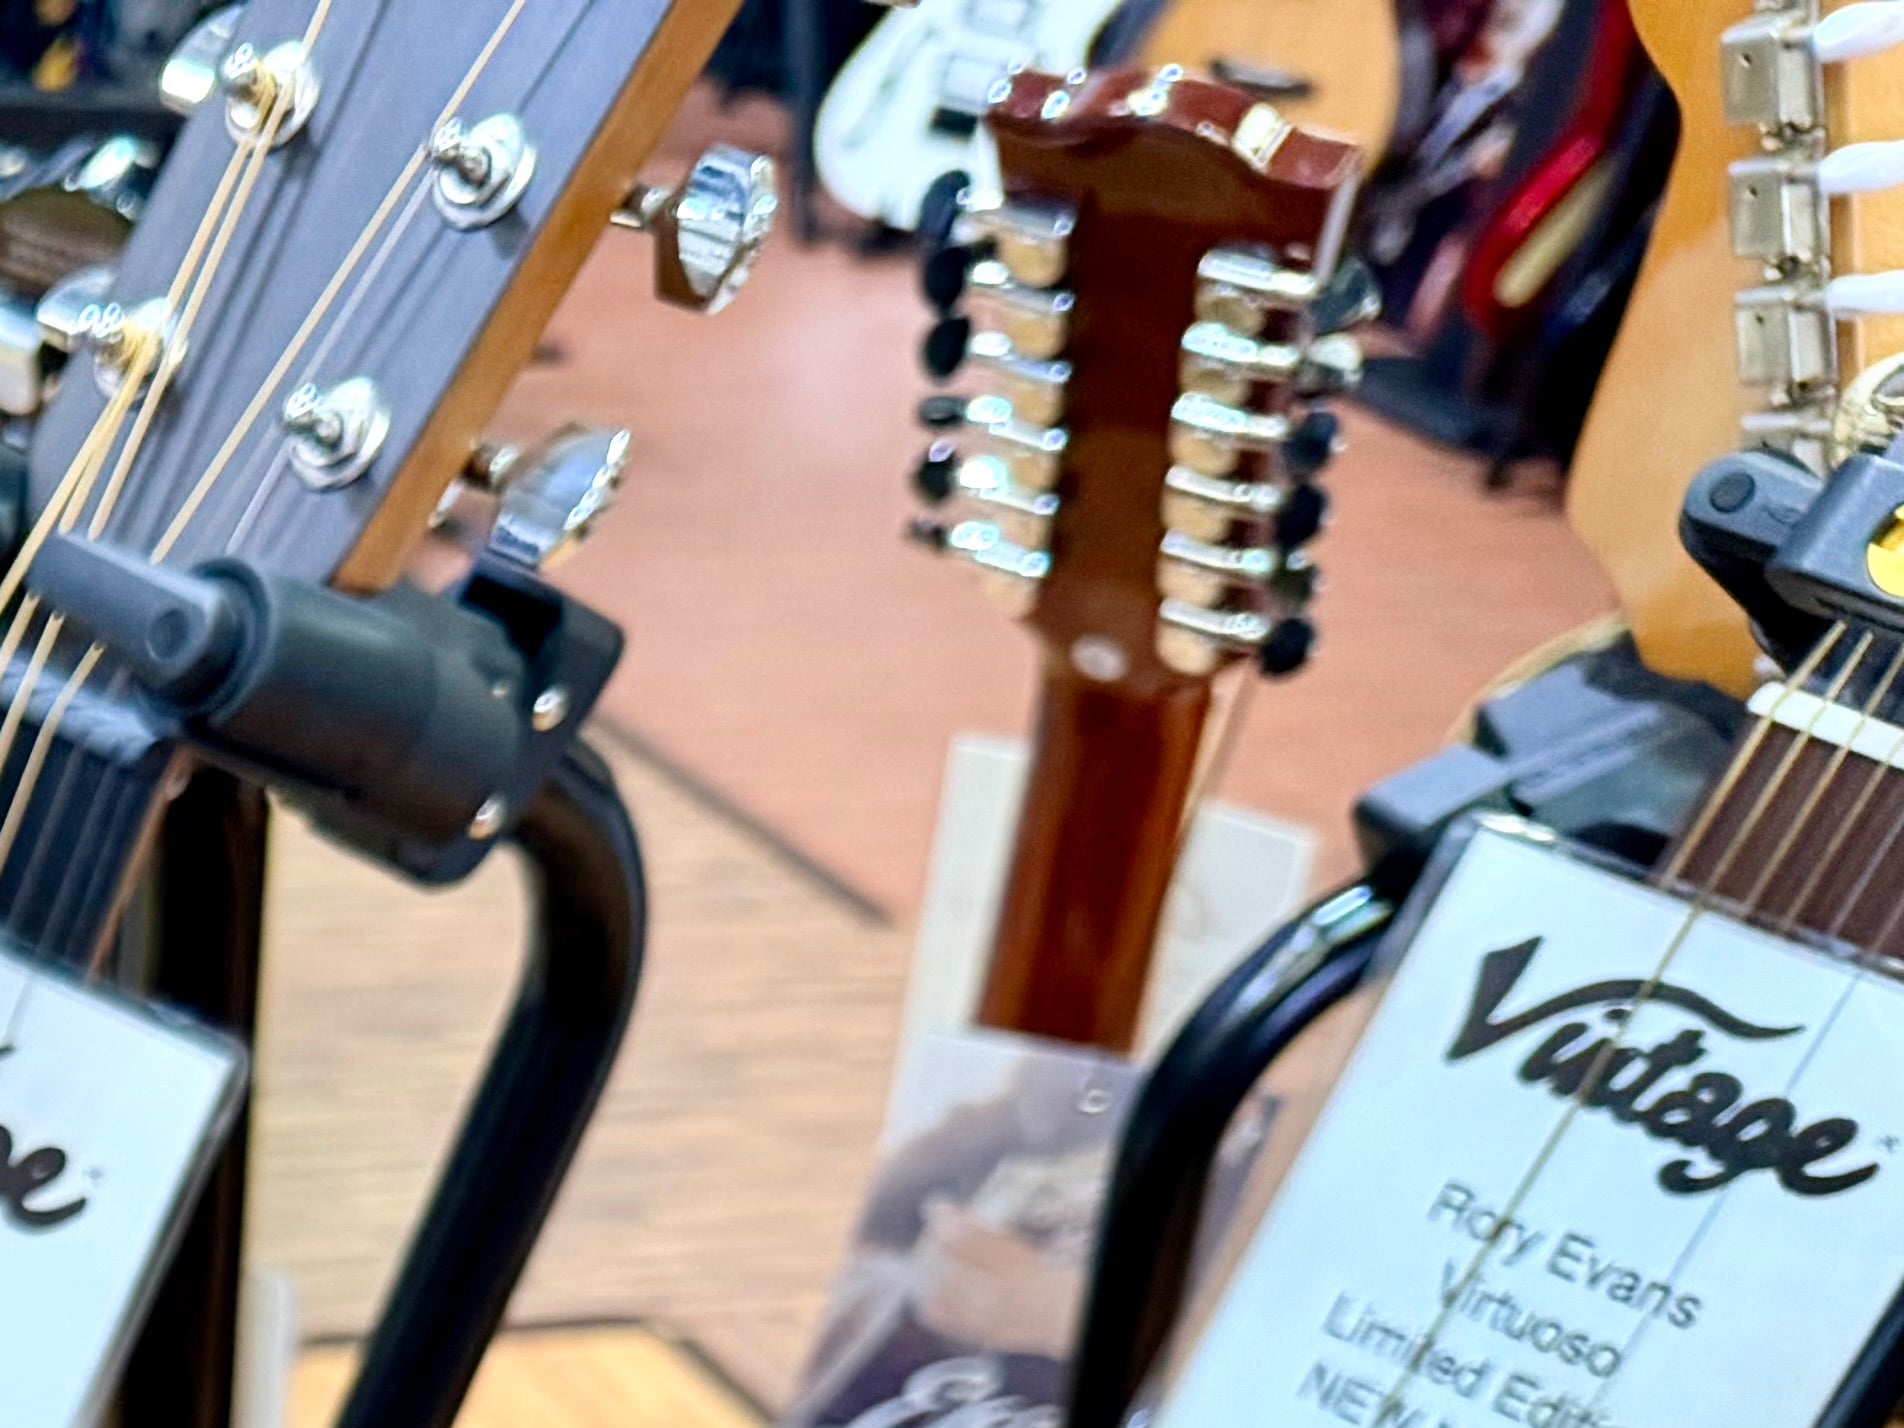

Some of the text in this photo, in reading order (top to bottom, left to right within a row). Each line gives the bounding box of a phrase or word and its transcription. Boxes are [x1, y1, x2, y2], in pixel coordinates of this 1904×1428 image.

[1444, 934, 1880, 1197] Vintage
[1428, 1180, 1702, 1331] Rory Evans
[1440, 1259, 1622, 1379] Virtuoso
[1322, 1291, 1492, 1399] Limied
